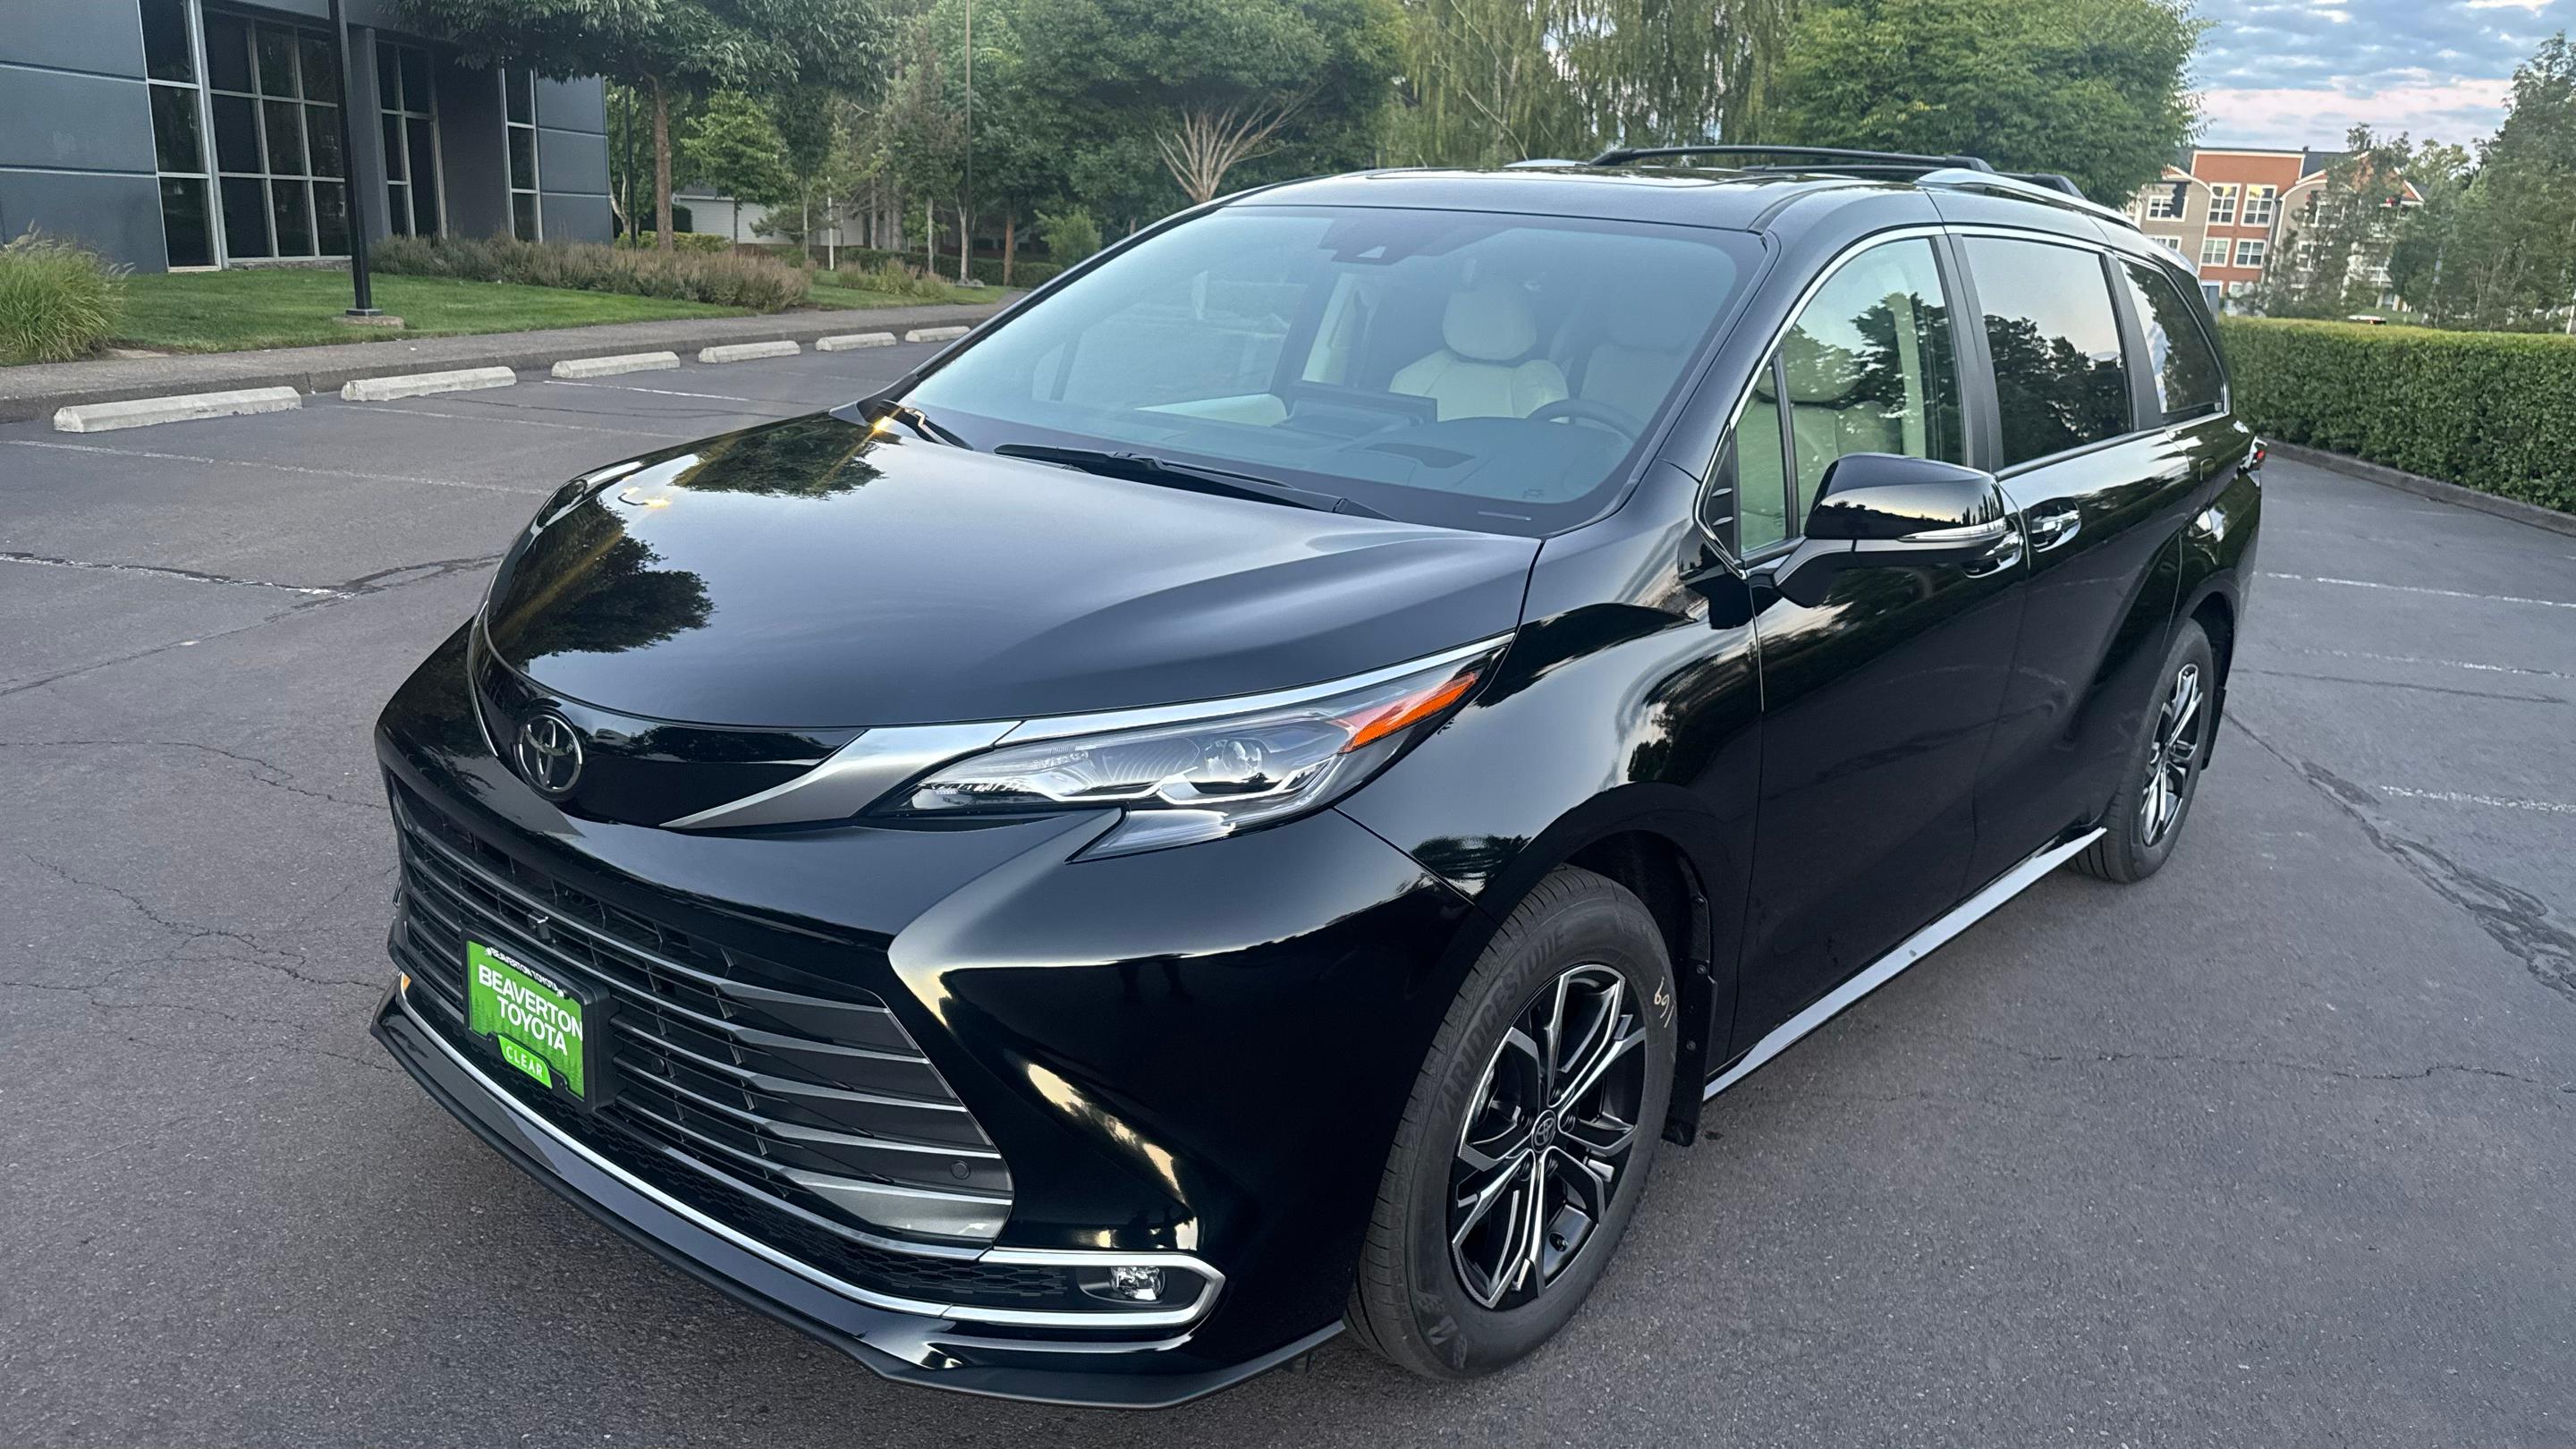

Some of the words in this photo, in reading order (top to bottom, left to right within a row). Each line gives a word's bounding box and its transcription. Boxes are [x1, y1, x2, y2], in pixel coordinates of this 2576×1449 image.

[479, 964, 583, 1041] BEAVERTON
[497, 996, 568, 1055] TOYOTA
[1436, 925, 1563, 1120] BRIDGESTONE
[506, 1046, 543, 1078] CLEAR
